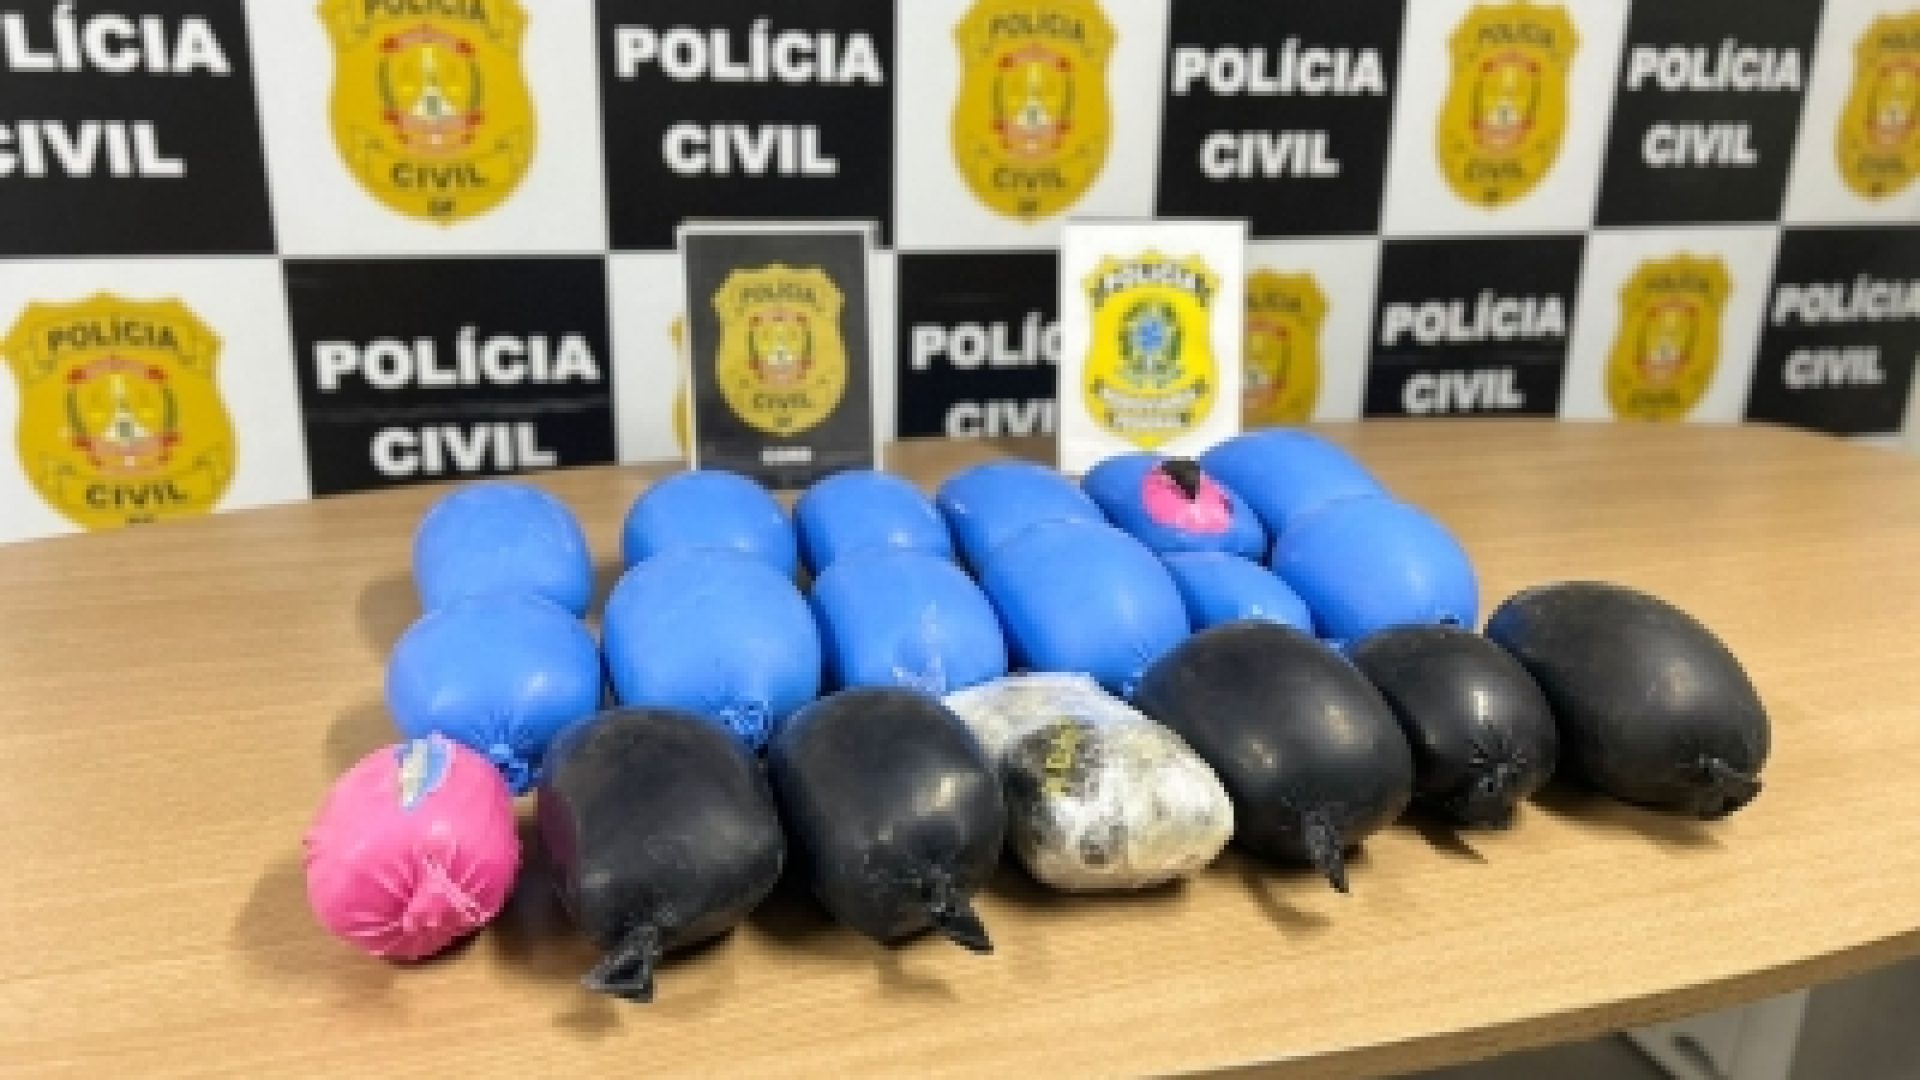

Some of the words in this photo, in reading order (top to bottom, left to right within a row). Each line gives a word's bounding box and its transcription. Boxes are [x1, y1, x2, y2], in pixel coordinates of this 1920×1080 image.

[613, 18, 883, 83] POLÍCIA
[989, 14, 1085, 42] POLÍCIA
[1171, 37, 1386, 96] POLÍCIA
[1628, 38, 1801, 91] POLÍCIA
[662, 124, 837, 175] CIVIL
[1199, 129, 1340, 179] CIVIL
[1641, 123, 1759, 168] CIVIL
[391, 163, 488, 190] CIVIL
[993, 163, 1066, 191] CIVIL
[48, 314, 178, 350] POLÍCIA
[1382, 288, 1566, 346] POLÍCIA
[315, 325, 602, 390] POLÍCIA
[1783, 347, 1886, 390] CIVIL
[1401, 368, 1524, 413] CIVIL
[370, 422, 558, 477] CIVIL
[86, 481, 188, 509] CIVIL
